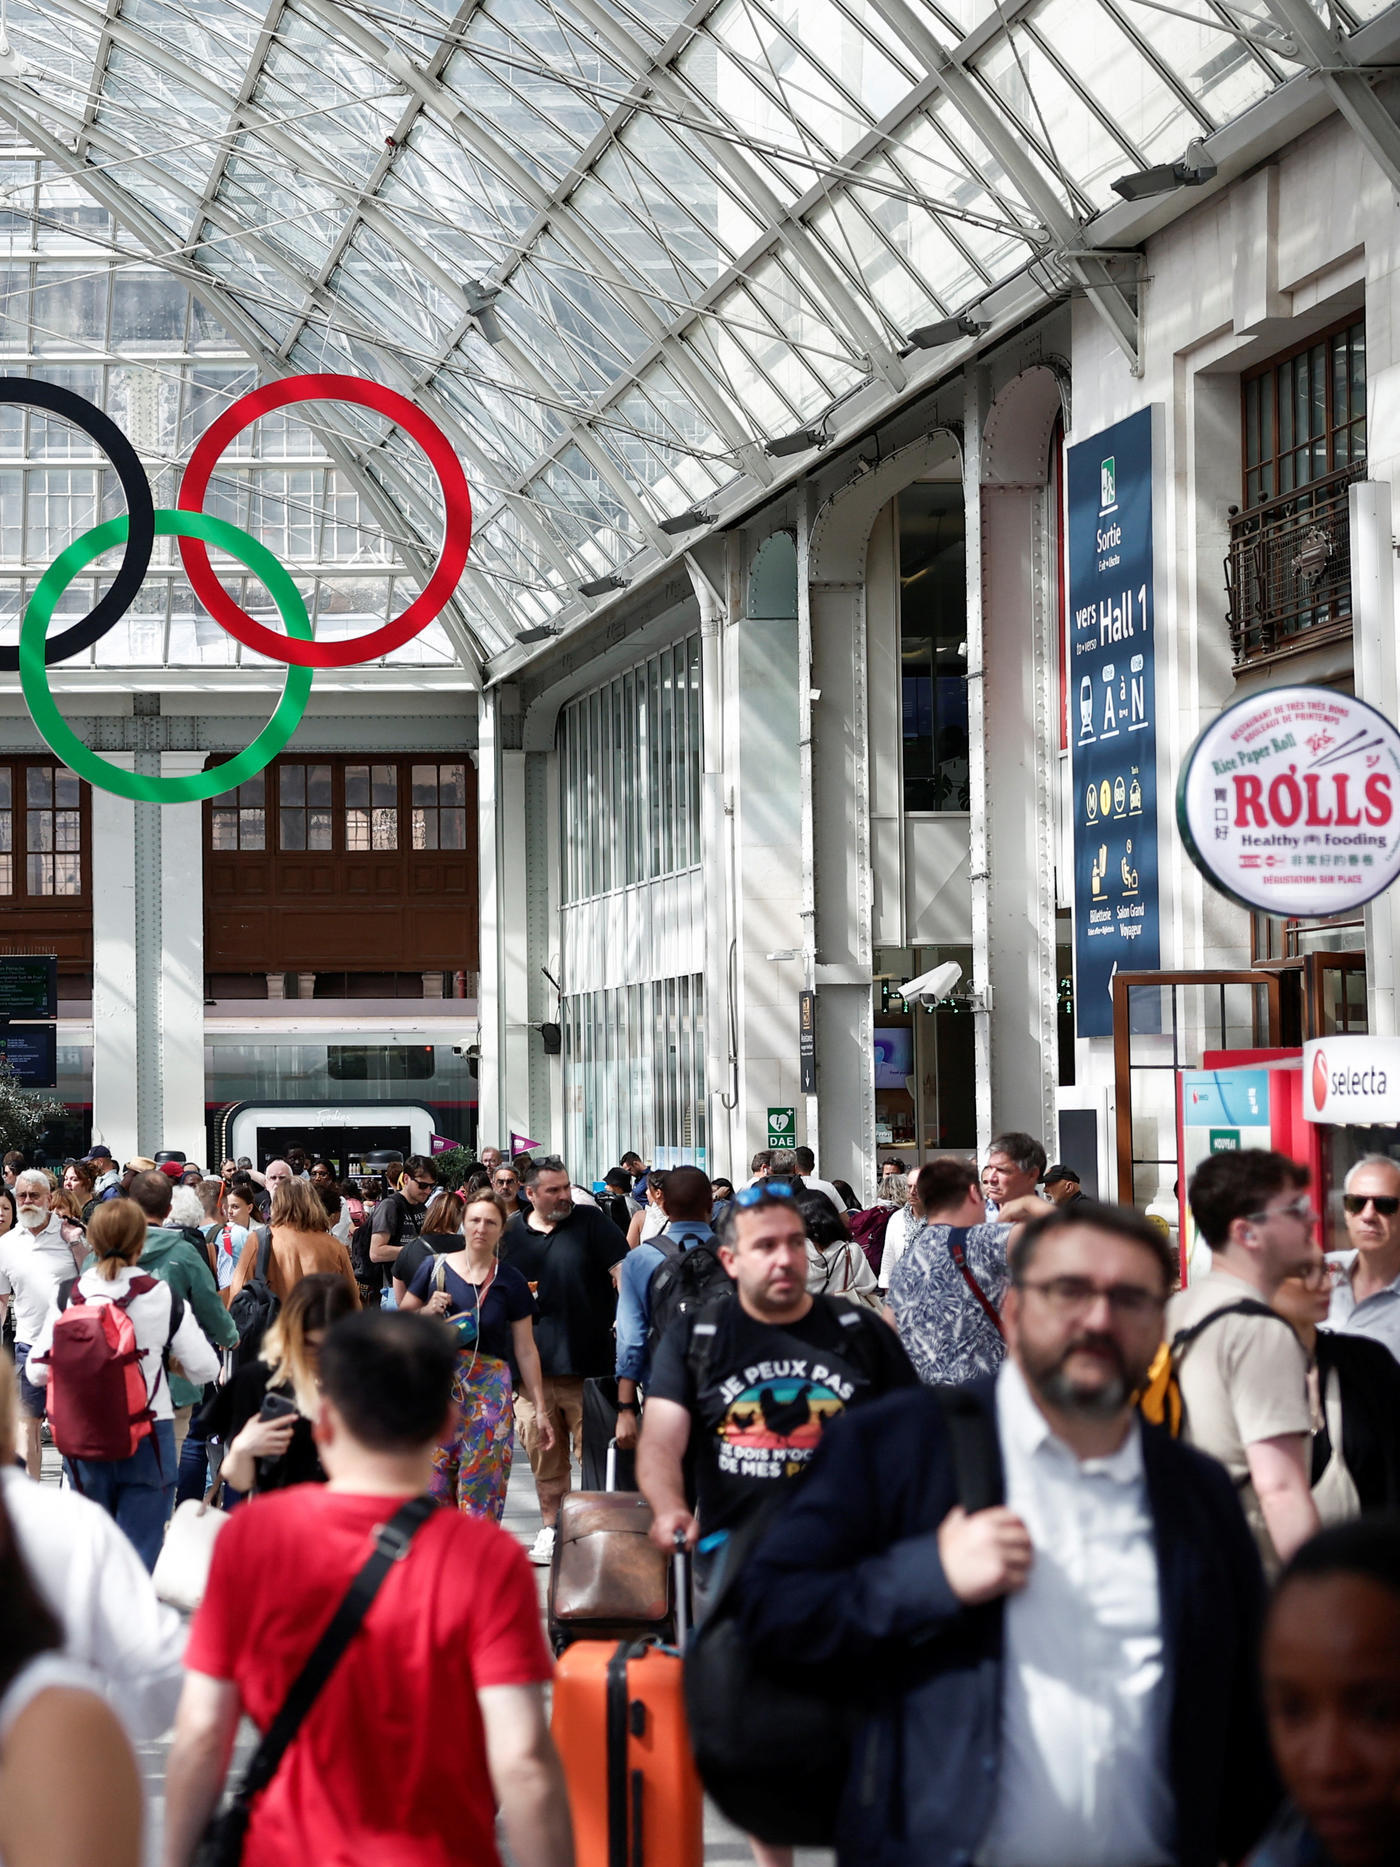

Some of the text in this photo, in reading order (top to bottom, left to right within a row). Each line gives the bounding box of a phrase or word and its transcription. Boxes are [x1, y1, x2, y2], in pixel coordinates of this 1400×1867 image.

[1096, 522, 1121, 553] Sortie
[1075, 583, 1147, 646] vers Hall 1
[1103, 675, 1145, 731] A à N
[1230, 709, 1273, 742] RESTAURANT
[1211, 732, 1297, 776] Rice Paper Roll
[1241, 834, 1300, 848] Healthy
[1130, 902, 1145, 917] Grand
[1331, 1066, 1388, 1096] selecta
[770, 1137, 794, 1146] DAE
[718, 1360, 856, 1404] JE PEUX PAS
[718, 1455, 739, 1474] DE
[741, 1461, 781, 1478] MES
[732, 1444, 770, 1461] DOIS
